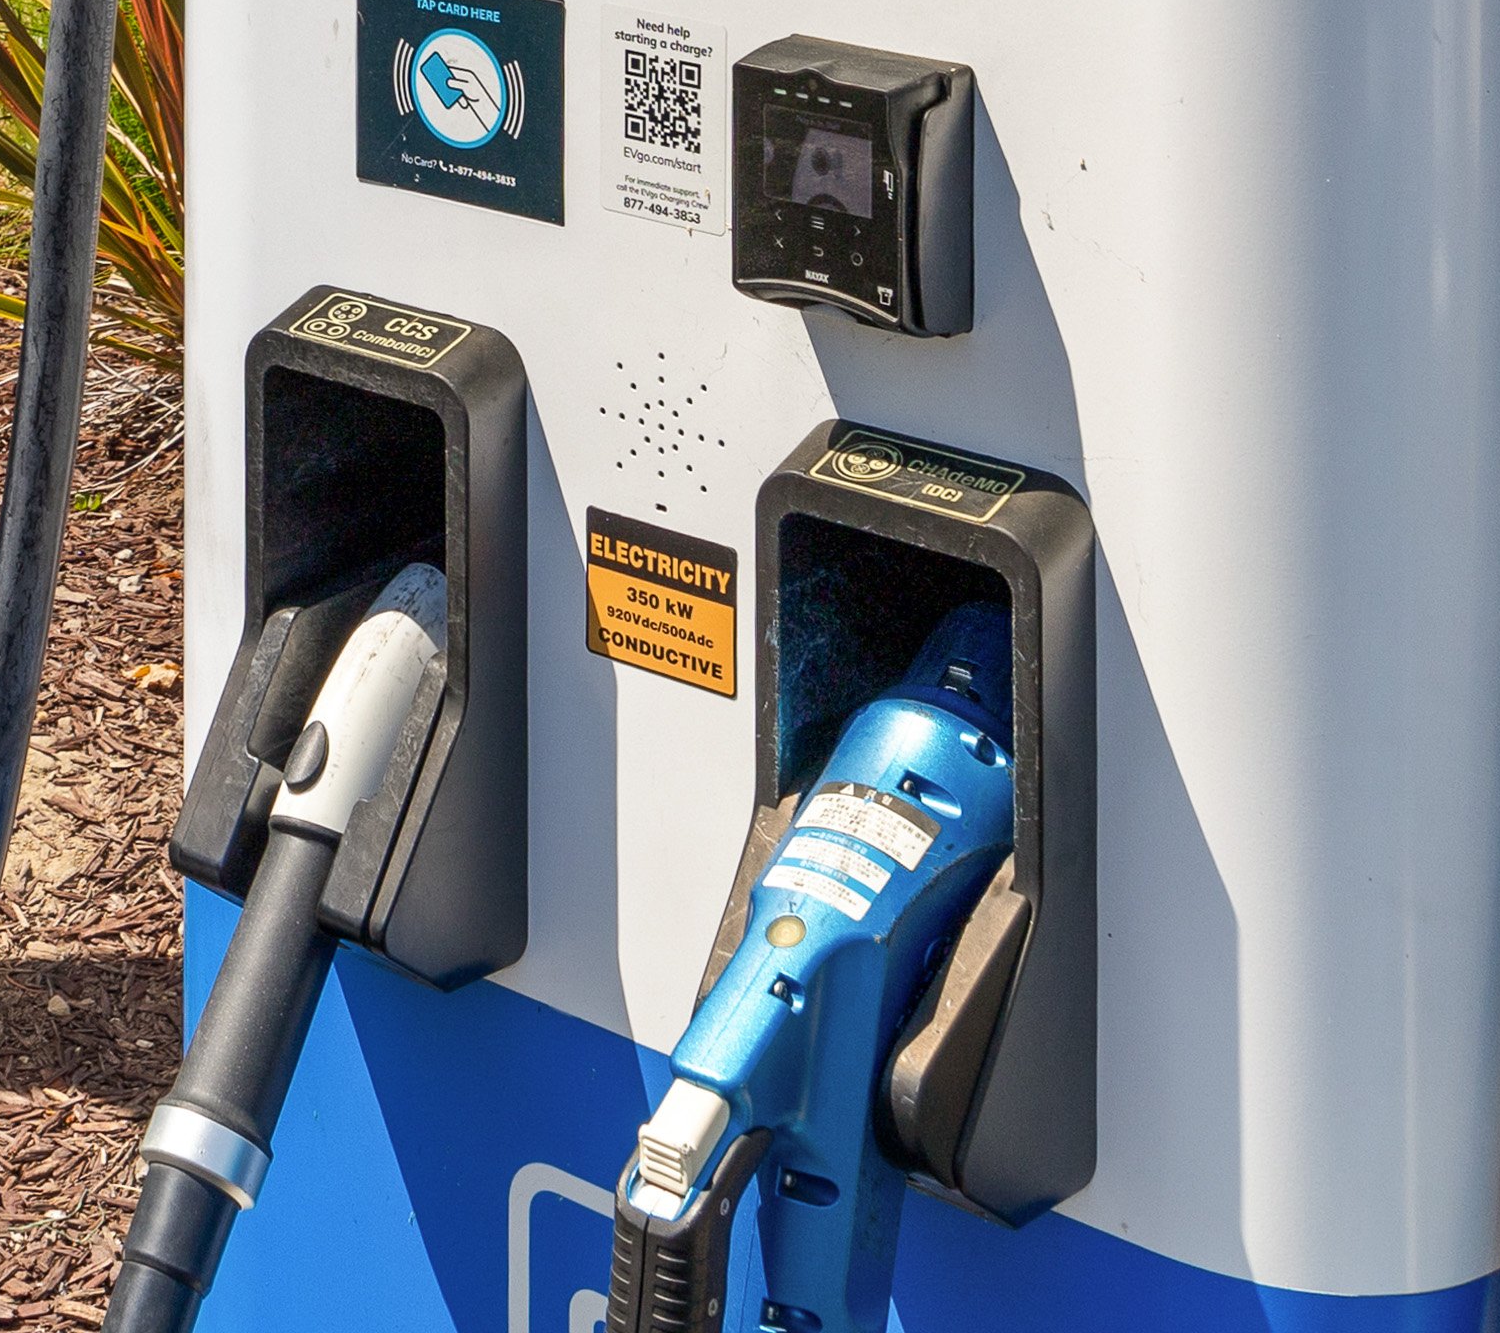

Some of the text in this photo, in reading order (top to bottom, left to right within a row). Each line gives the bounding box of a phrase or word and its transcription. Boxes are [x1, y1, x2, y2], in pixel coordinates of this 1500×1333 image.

[438, 2, 468, 17] CARD
[470, 8, 500, 22] HERE
[637, 18, 690, 39] Need help
[615, 31, 713, 57] starting a charge?
[402, 153, 413, 164] No
[414, 155, 437, 168] Card?
[624, 147, 701, 174] EVgo.com/start
[616, 183, 628, 193] call
[629, 185, 639, 196] the
[659, 192, 689, 208] Charging
[625, 175, 635, 183] For
[637, 176, 671, 192] immediate
[805, 269, 829, 283] NAYAX
[384, 318, 439, 340] CCS
[907, 459, 1009, 495] CHAdeMO
[591, 532, 730, 594] ELECTRICITY
[627, 587, 693, 619] 350 kW
[607, 606, 714, 649] 920Vdc/500Adc
[600, 628, 723, 680] CONDUCTIVE
